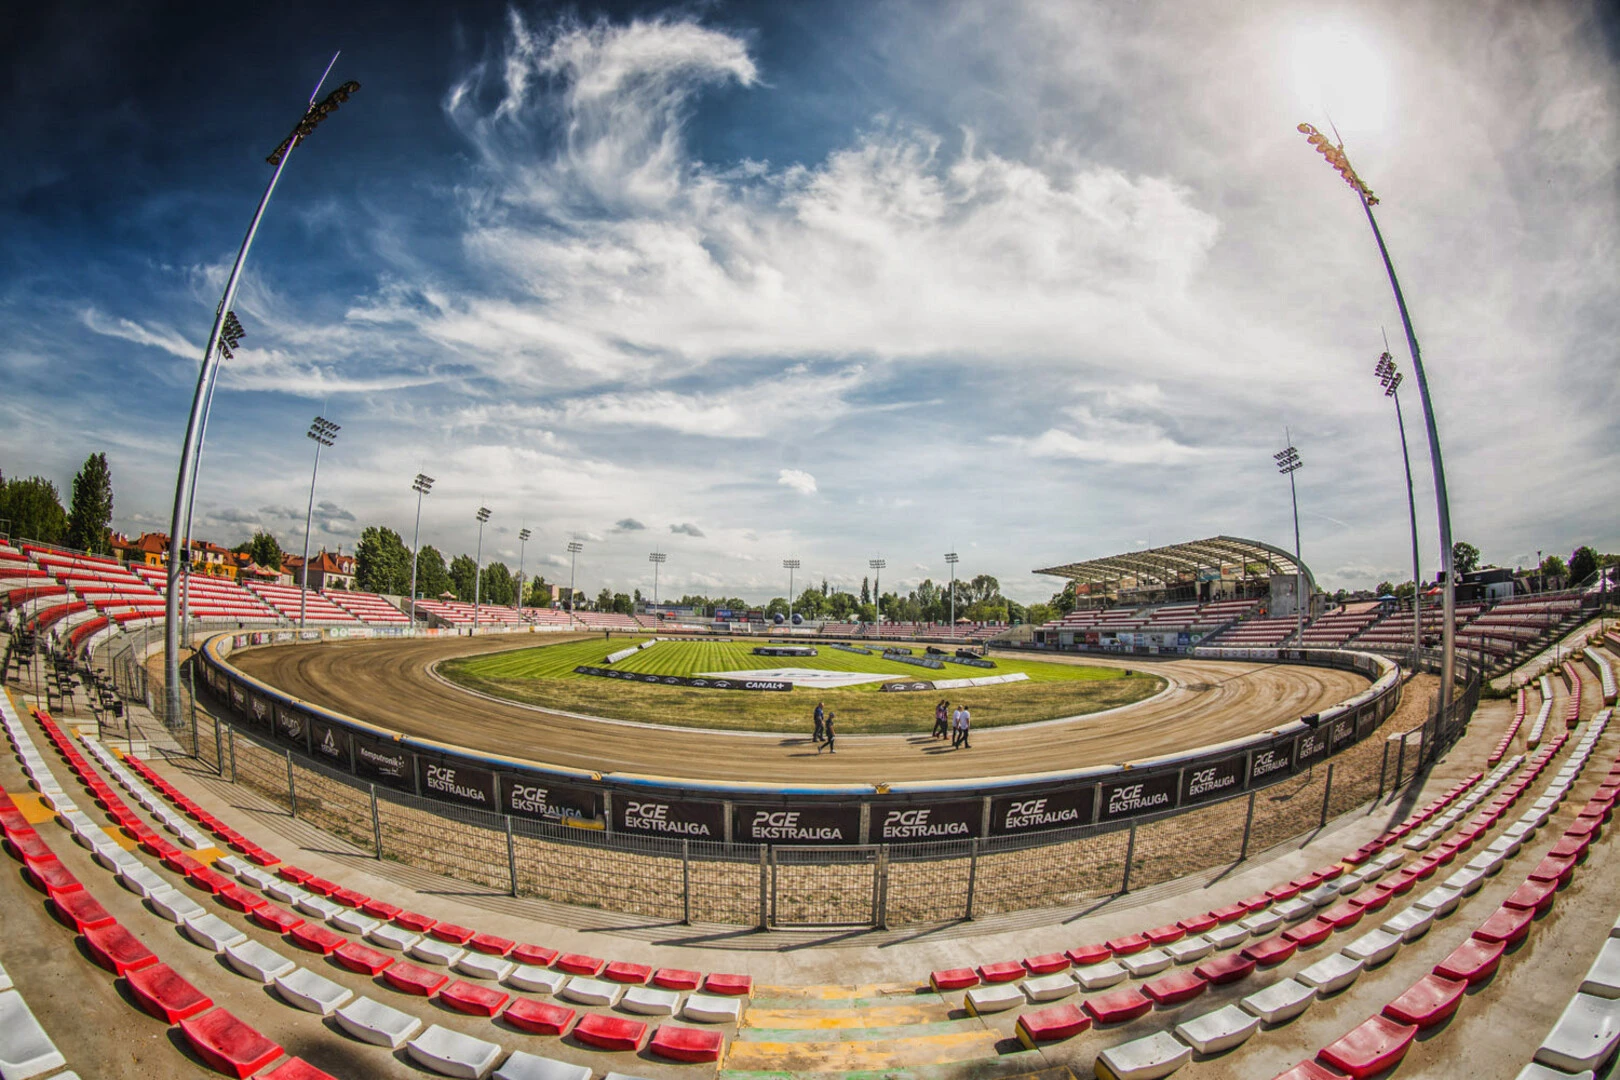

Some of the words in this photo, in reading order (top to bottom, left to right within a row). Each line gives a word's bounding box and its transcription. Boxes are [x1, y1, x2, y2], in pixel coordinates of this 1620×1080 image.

[745, 681, 785, 690] CANAL+
[361, 747, 399, 768] Komputronik
[1253, 757, 1288, 777] EKSTRALIGA
[1254, 750, 1275, 767] PGE
[427, 764, 456, 783] PGE
[1190, 767, 1217, 786] PGE
[427, 777, 486, 802] EKSTRALIGA
[511, 784, 548, 803] PGE
[1109, 784, 1144, 802] PGE
[1189, 775, 1235, 796] EKSTRALIGA
[511, 799, 583, 819] EKSTRALIGA
[625, 801, 669, 820] PGE
[1006, 798, 1048, 817] PGE
[1108, 792, 1169, 814] EKSTRALIGA
[624, 816, 711, 836] EKSTRALIGA
[752, 811, 800, 827] PGE
[884, 809, 931, 826] PGE
[1005, 808, 1079, 829] EKSTRALIGA
[752, 826, 843, 840] EKSTRALIGA
[883, 822, 969, 838] EKSTRALIGA
